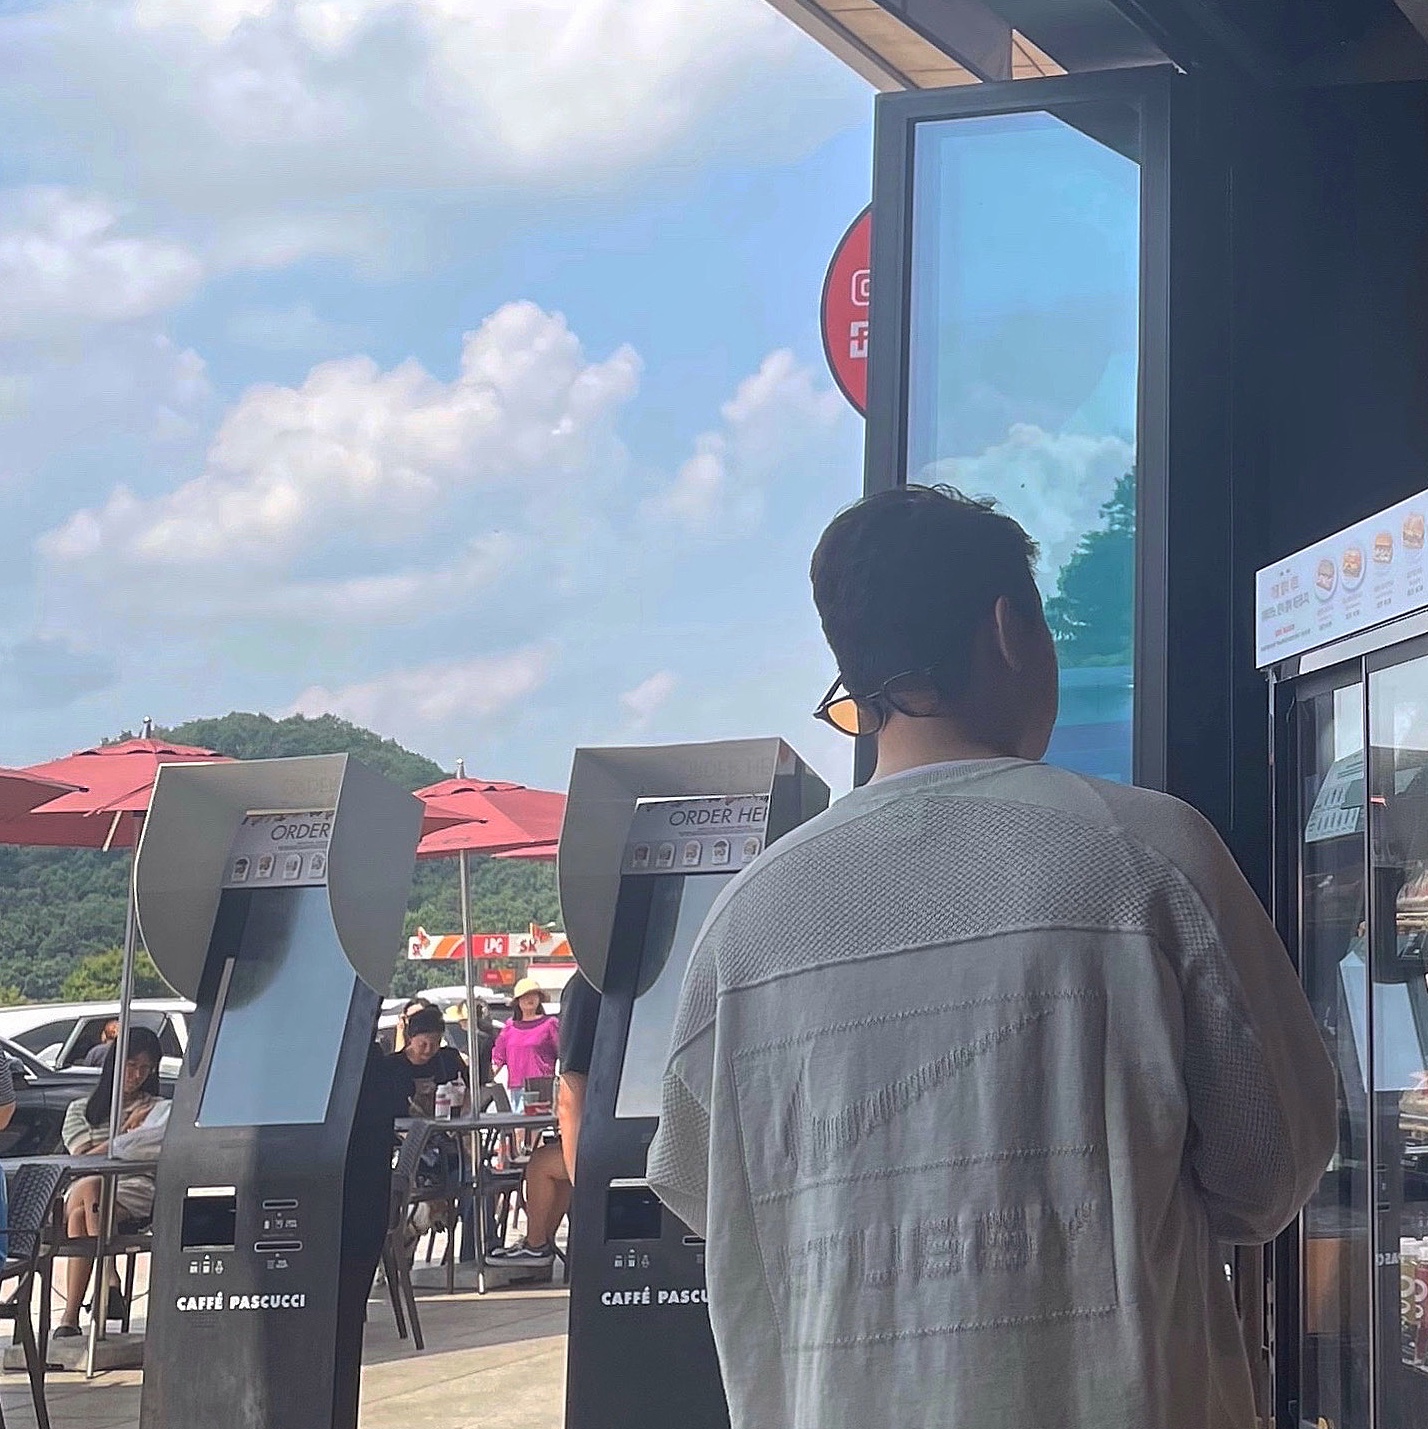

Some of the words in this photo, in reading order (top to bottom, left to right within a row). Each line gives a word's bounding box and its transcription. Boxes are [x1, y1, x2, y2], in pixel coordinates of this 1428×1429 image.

[670, 807, 732, 827] ORDER
[270, 822, 331, 841] ORDER
[483, 937, 504, 954] LPG
[519, 939, 538, 954] SK
[229, 1294, 306, 1310] PASCUCCI
